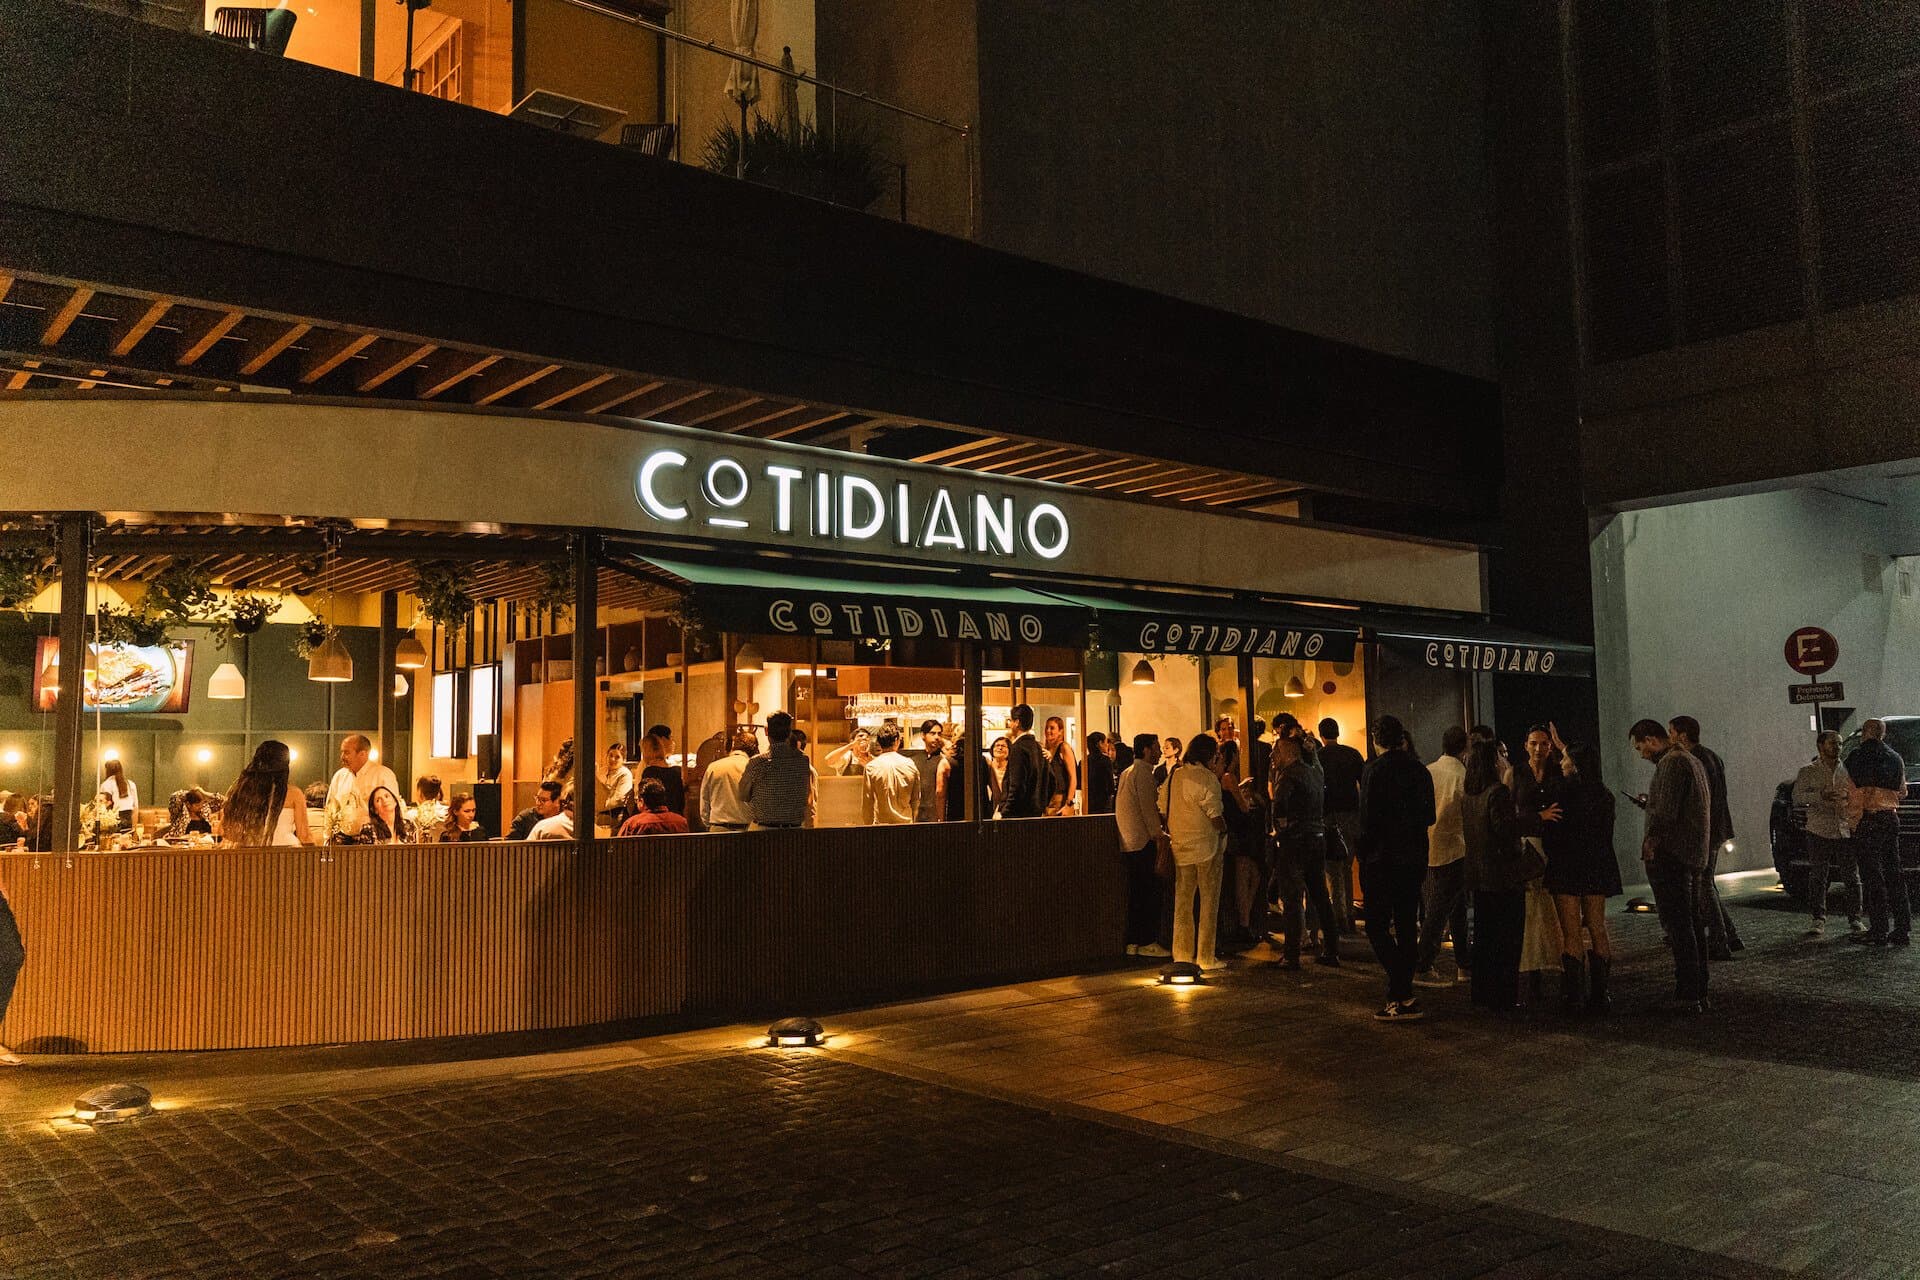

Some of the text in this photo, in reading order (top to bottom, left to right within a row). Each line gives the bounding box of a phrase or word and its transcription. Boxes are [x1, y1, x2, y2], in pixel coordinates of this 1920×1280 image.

[636, 450, 1070, 559] COTIDIANO
[768, 600, 1043, 644] COTIDIANO
[1139, 622, 1325, 658] COTIDIANO
[1425, 642, 1555, 674] COTIDIANO
